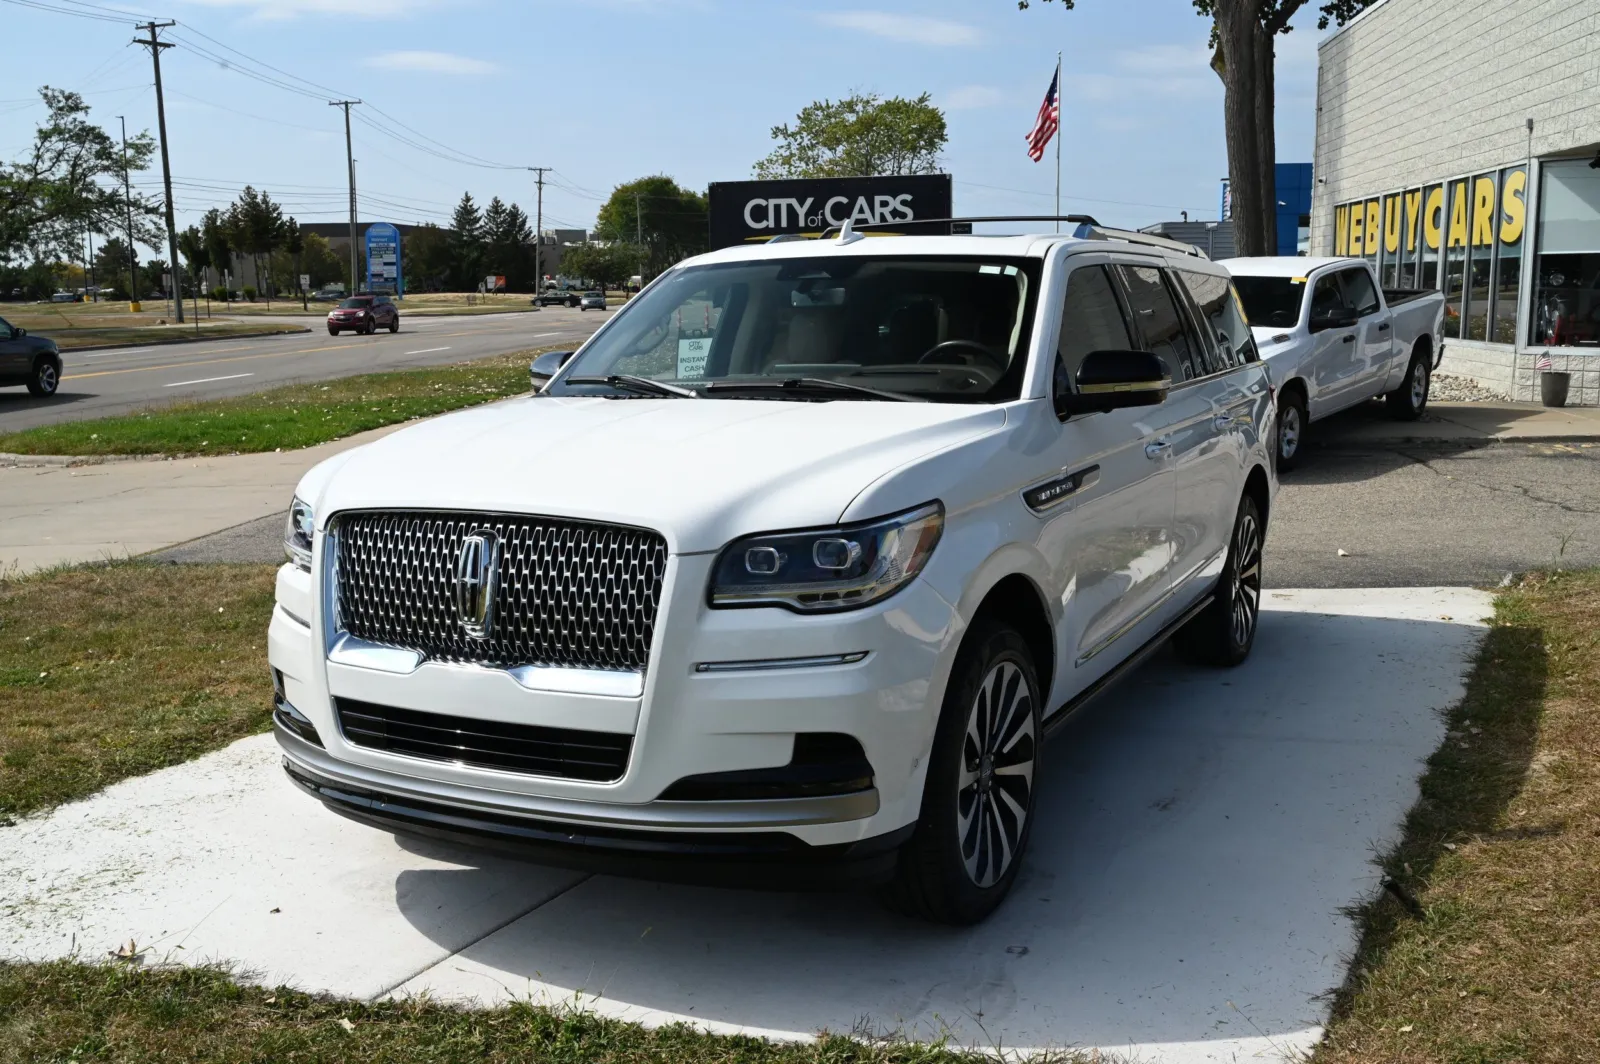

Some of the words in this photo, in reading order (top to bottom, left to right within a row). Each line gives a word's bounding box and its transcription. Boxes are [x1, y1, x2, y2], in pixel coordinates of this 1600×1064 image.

[744, 197, 814, 229] CITY
[807, 210, 823, 227] of
[824, 193, 914, 227] CARS
